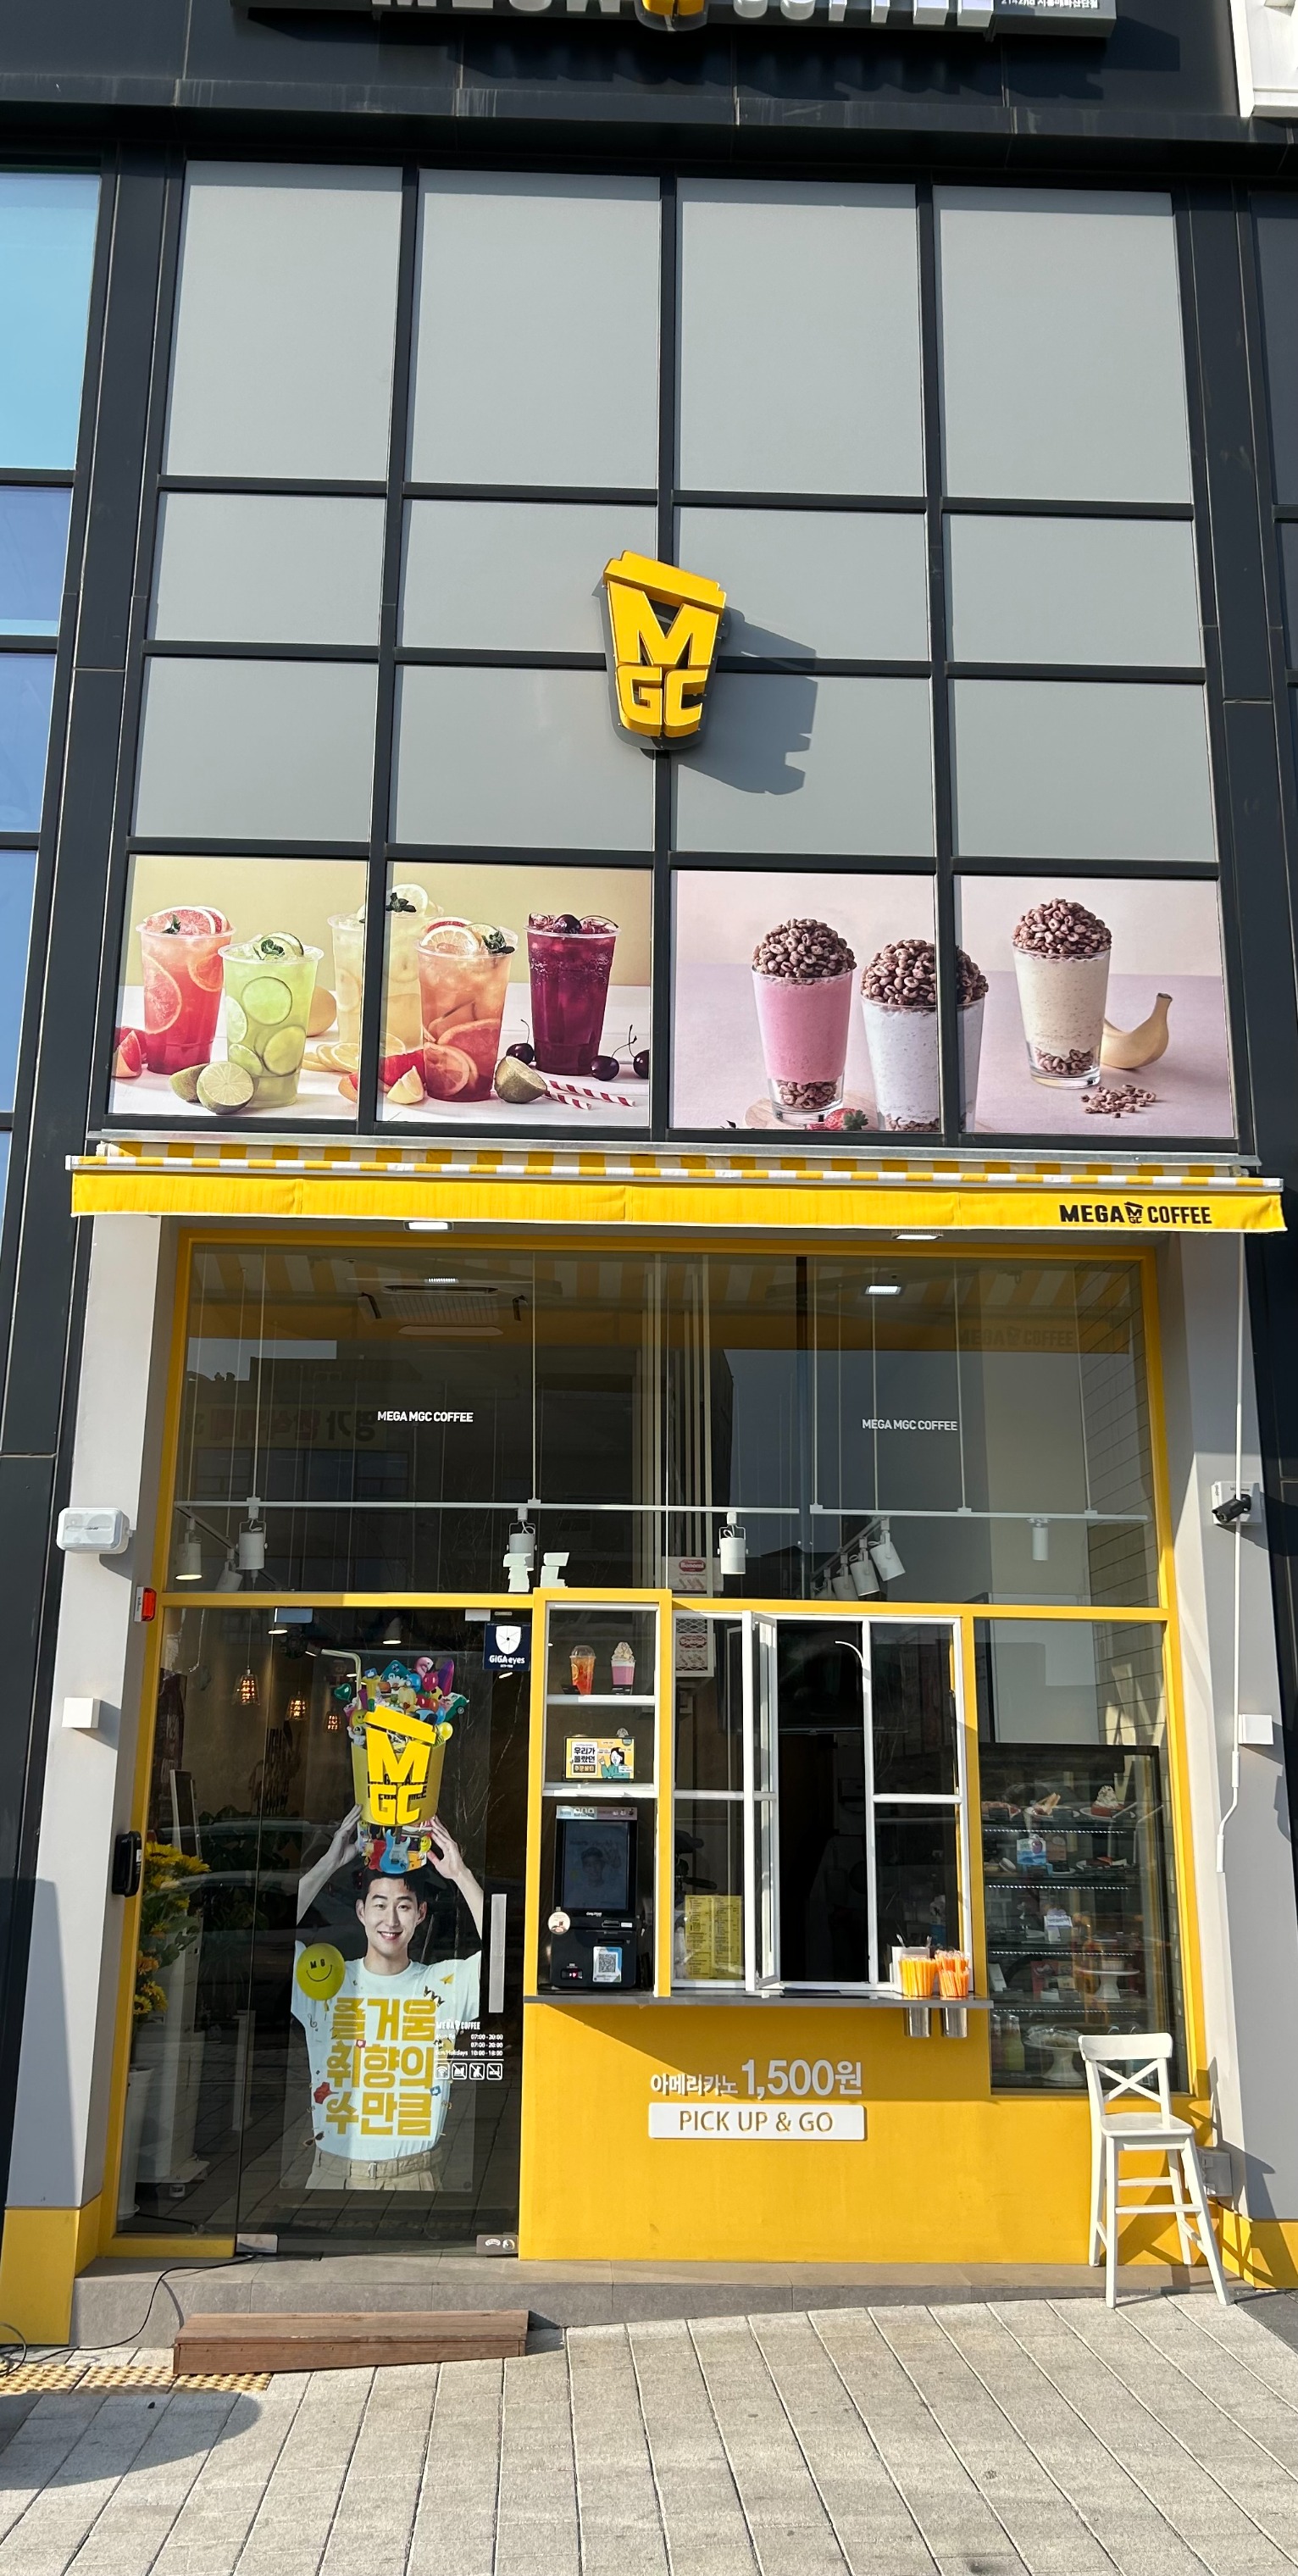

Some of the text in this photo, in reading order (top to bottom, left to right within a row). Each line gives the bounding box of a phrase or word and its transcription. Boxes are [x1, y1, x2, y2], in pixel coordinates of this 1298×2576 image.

[1059, 1204, 1212, 1224] MEGA COFFEE
[377, 1411, 474, 1423] MEGA MGC COFFEE
[862, 1418, 958, 1431] MEGA MGC COFFEE
[574, 1746, 596, 1755] 우리가
[574, 1755, 596, 1763] 몰랐던
[331, 1997, 437, 2041] 즐거움
[460, 2021, 481, 2030] COFFEE
[326, 2041, 434, 2090] 취향의
[650, 2058, 863, 2101] 아메리카노 1,500원
[325, 2091, 433, 2136] 수만큼
[679, 2110, 834, 2133] PICK UP & GO
